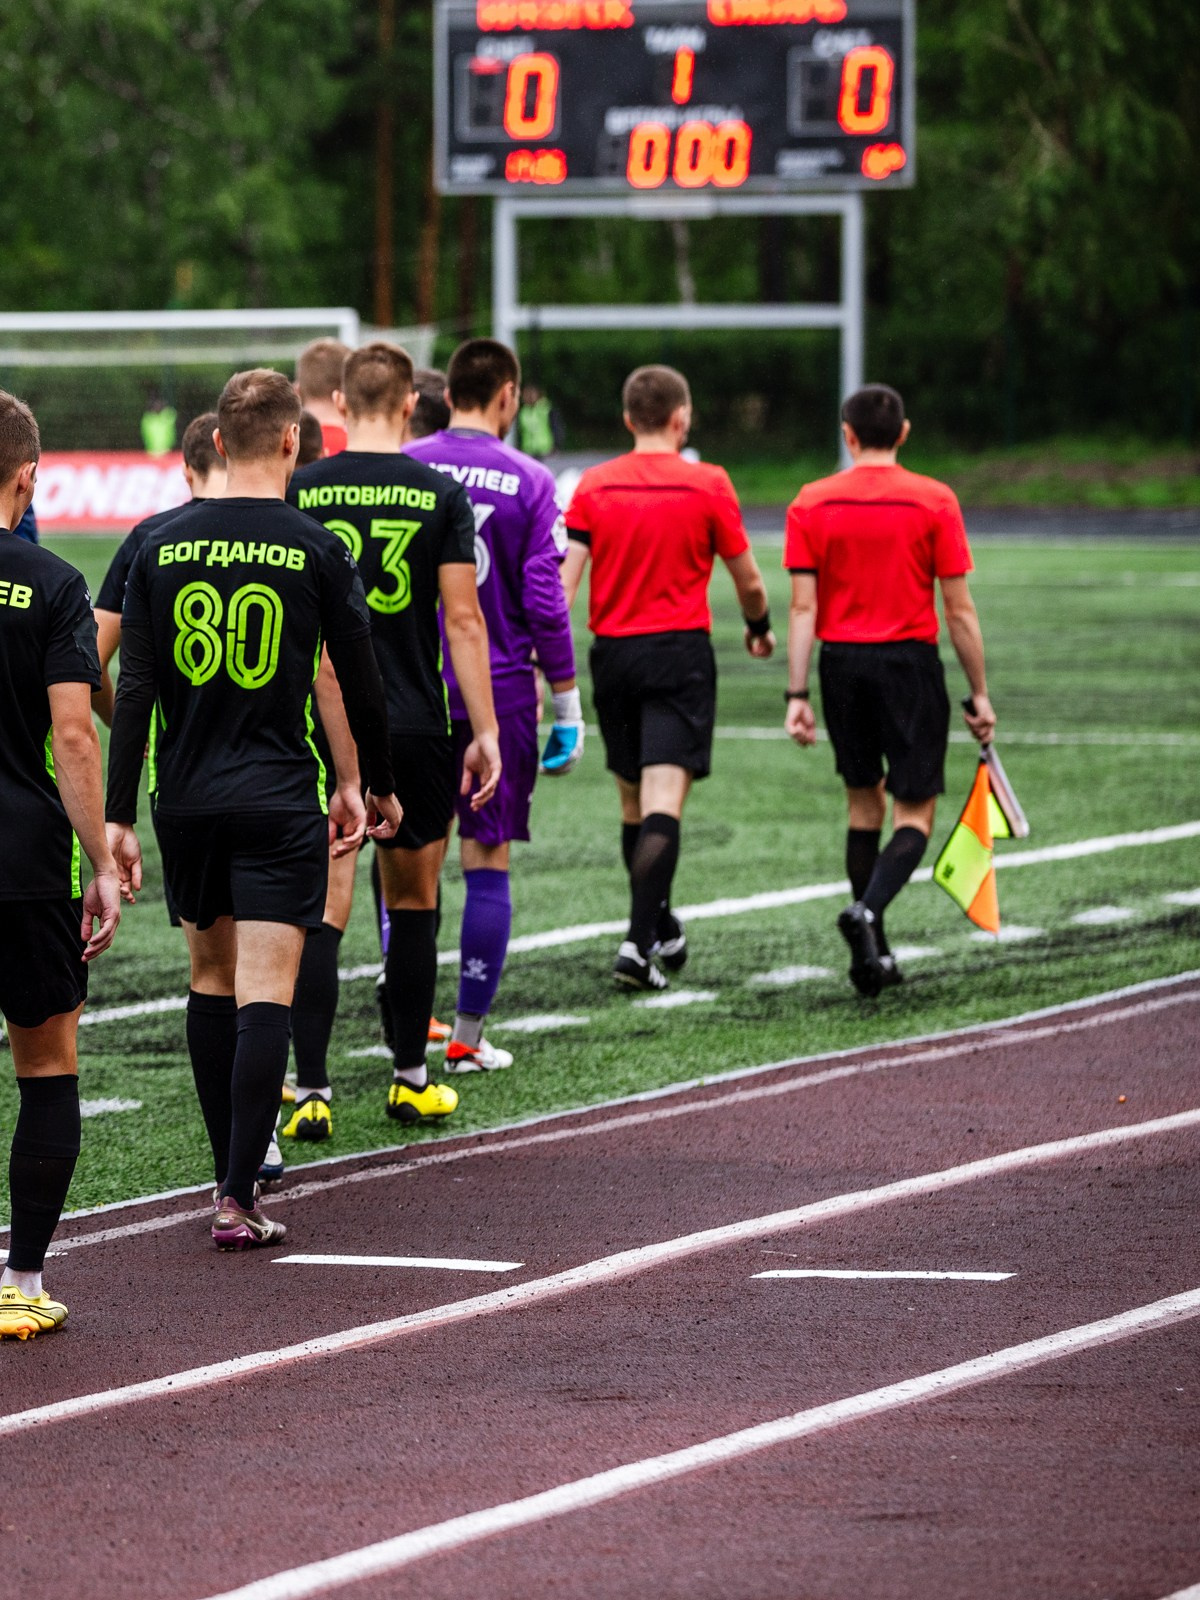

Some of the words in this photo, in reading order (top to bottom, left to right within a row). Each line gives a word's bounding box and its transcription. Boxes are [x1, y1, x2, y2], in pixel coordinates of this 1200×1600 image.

[504, 52, 560, 141] 0
[837, 46, 895, 135] 0
[298, 485, 437, 512] МОТОВИЛОВ
[158, 540, 306, 571] БОГДАНОВ
[173, 580, 284, 690] 80
